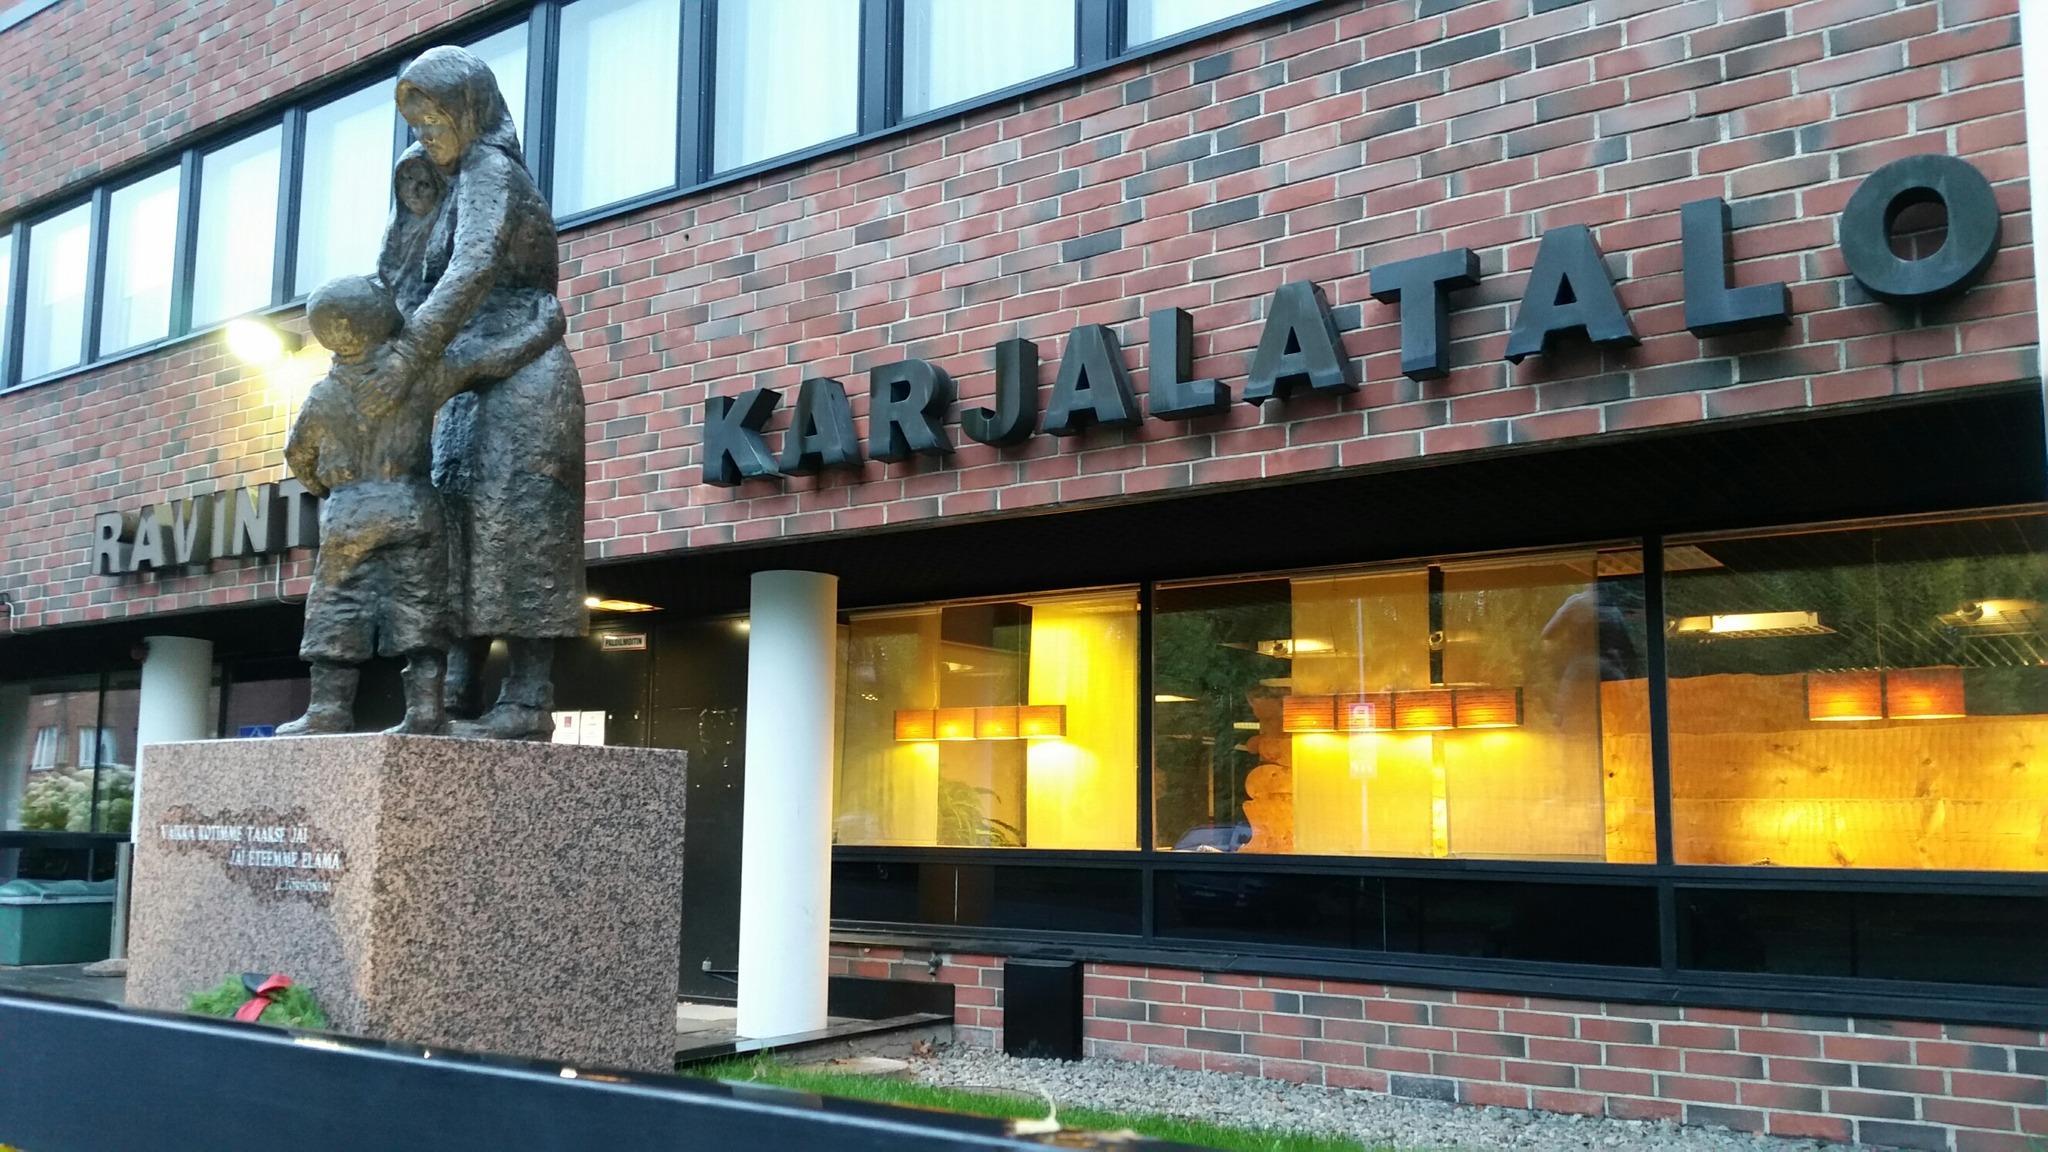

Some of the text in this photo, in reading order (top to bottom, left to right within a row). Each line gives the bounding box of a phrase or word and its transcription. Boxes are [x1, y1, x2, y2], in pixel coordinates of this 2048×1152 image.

[702, 153, 2002, 488] KARJALATALO
[160, 823, 308, 844] VAIKKA KOTIMME TAAKSE JÄI
[228, 846, 341, 870] JÄI ETEEMME ELÄMÄ
